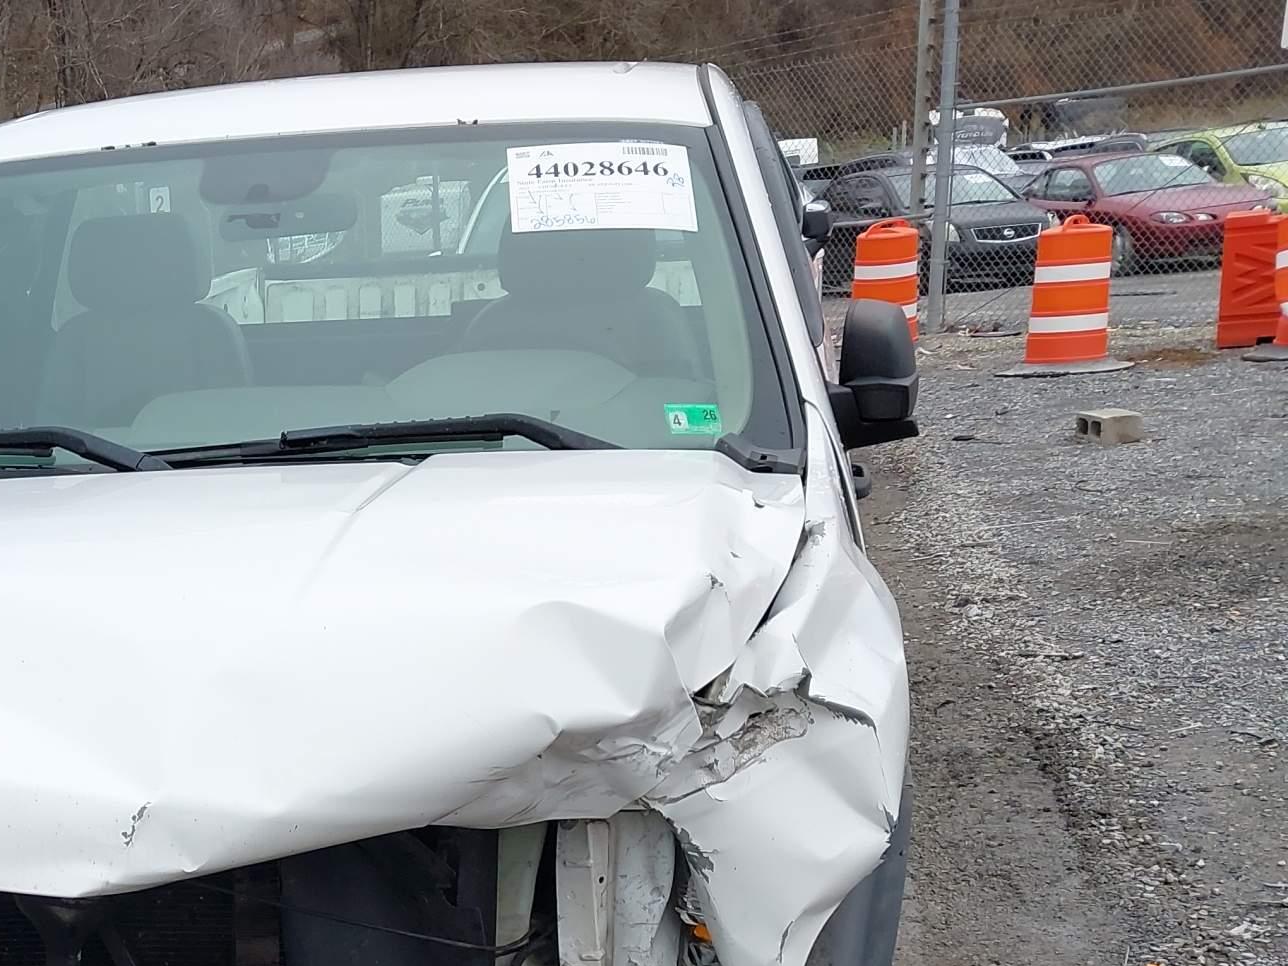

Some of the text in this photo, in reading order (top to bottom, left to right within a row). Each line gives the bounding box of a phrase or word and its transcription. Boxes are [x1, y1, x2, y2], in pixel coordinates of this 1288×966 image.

[527, 160, 669, 178] 44028646
[672, 409, 717, 426] 4 26
